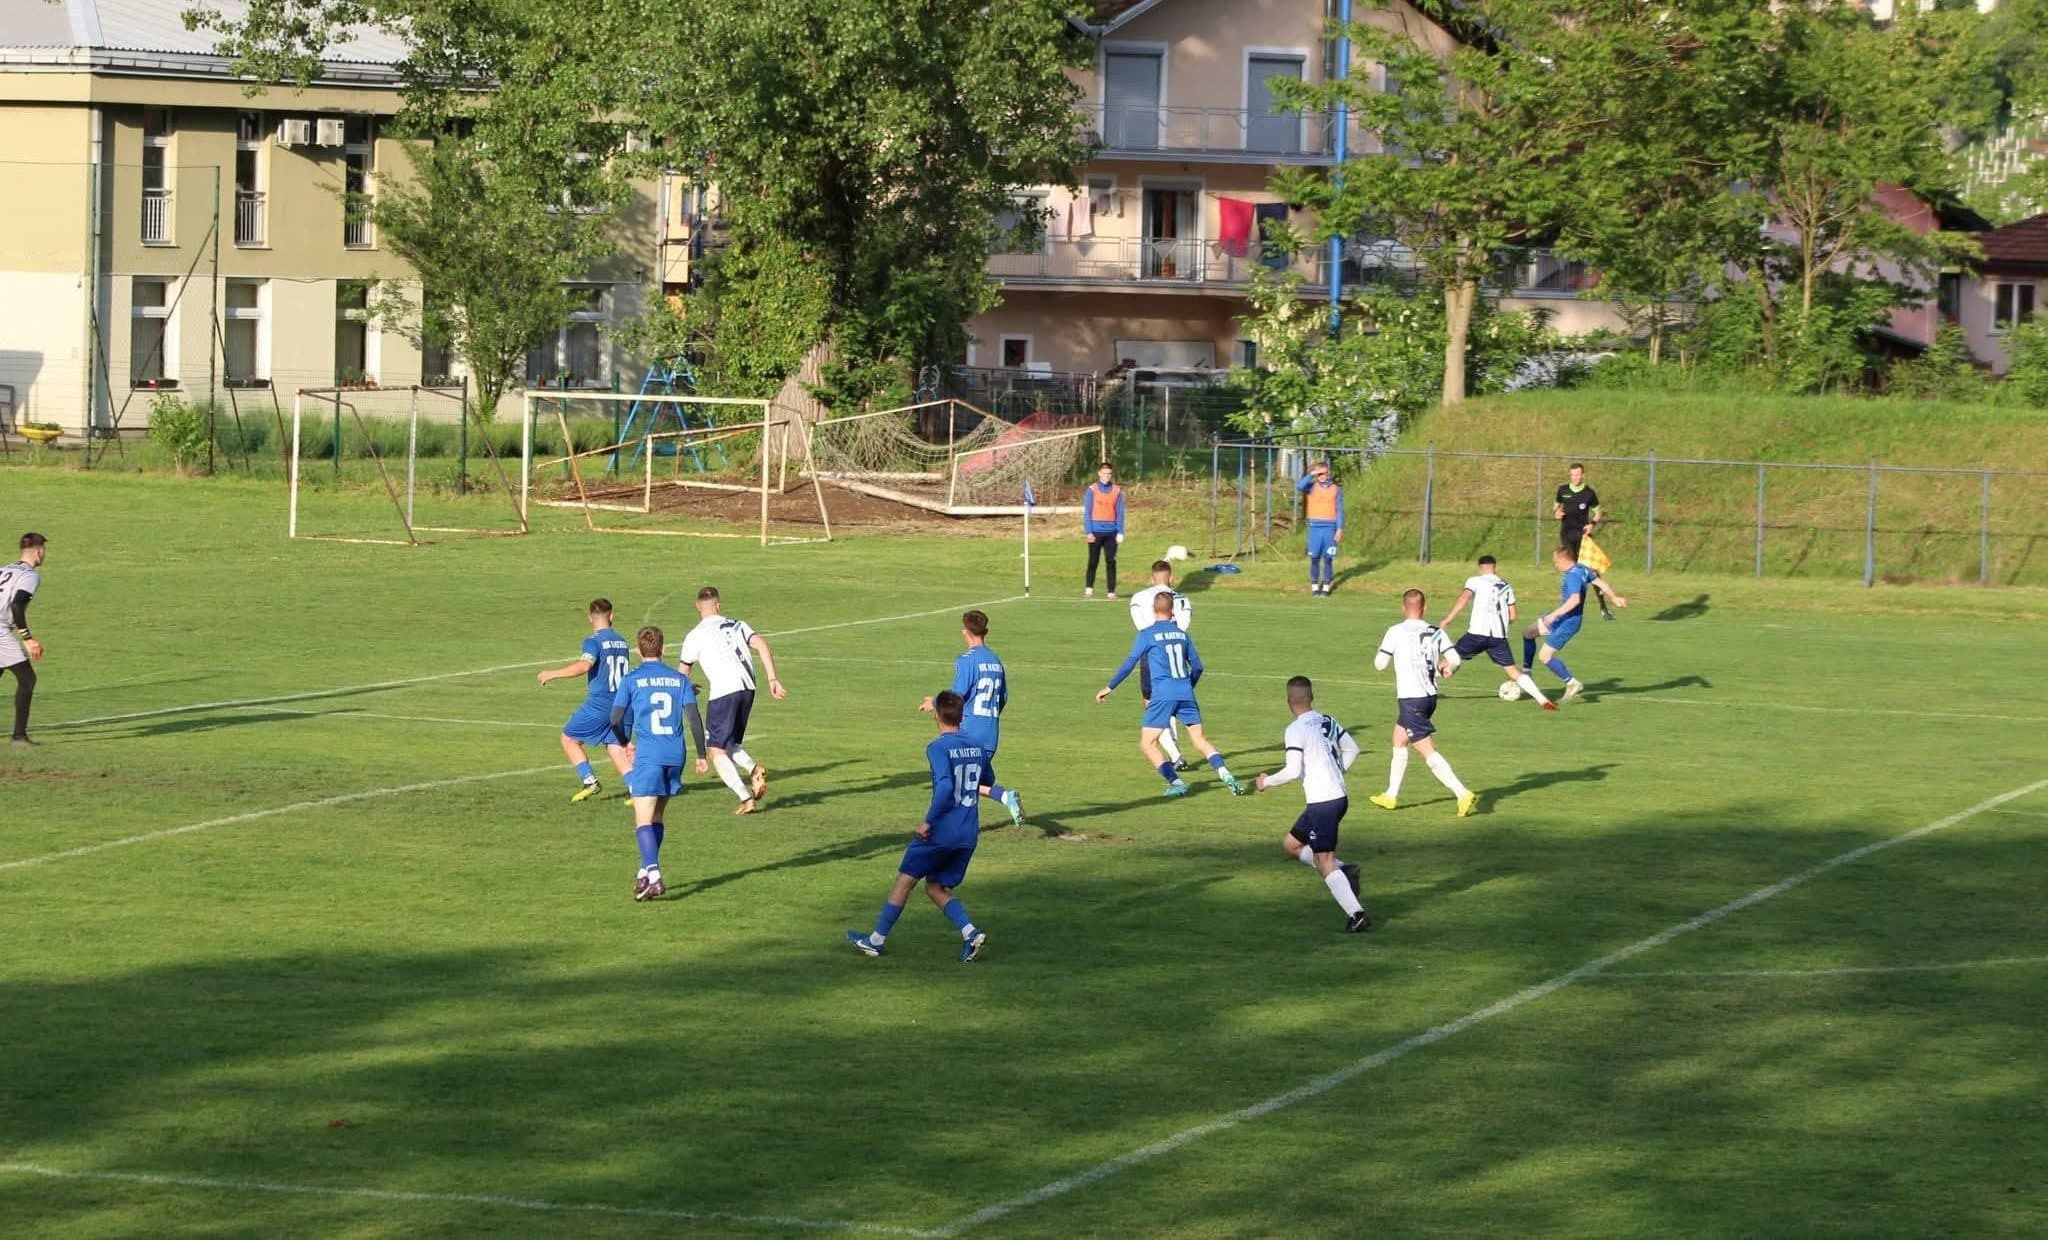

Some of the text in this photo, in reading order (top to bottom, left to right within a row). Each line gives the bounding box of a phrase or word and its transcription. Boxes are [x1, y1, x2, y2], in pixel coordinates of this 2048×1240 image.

[606, 655, 629, 692] 10
[1165, 643, 1186, 679] 11
[636, 677, 681, 688] NK NATRON
[650, 691, 674, 736] 2
[949, 748, 960, 759] NK
[953, 763, 982, 808] 19
